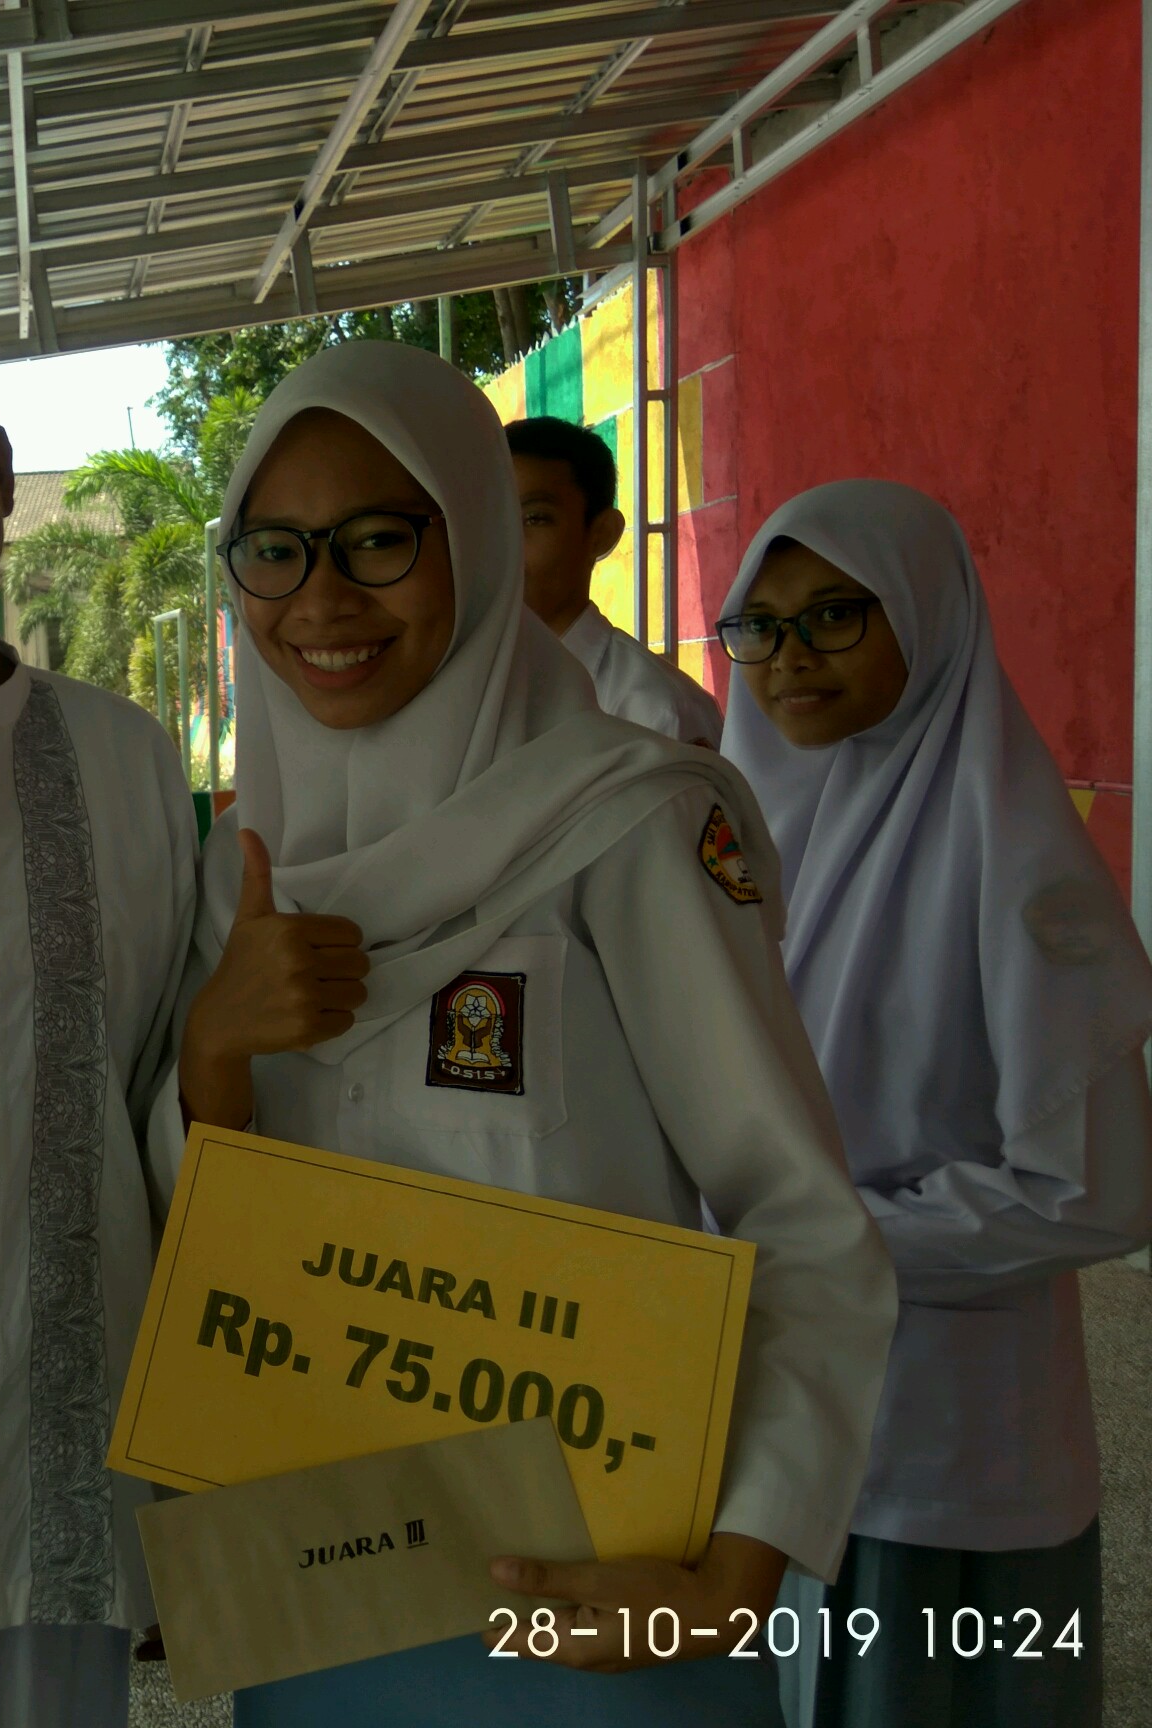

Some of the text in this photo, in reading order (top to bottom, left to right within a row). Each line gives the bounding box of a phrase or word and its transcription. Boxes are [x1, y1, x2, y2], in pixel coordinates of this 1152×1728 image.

[450, 1066, 496, 1080] OSIS
[301, 1242, 580, 1340] JUARA III
[196, 1288, 656, 1474] Rp. 75.000,-
[298, 1518, 430, 1569] JUARA III
